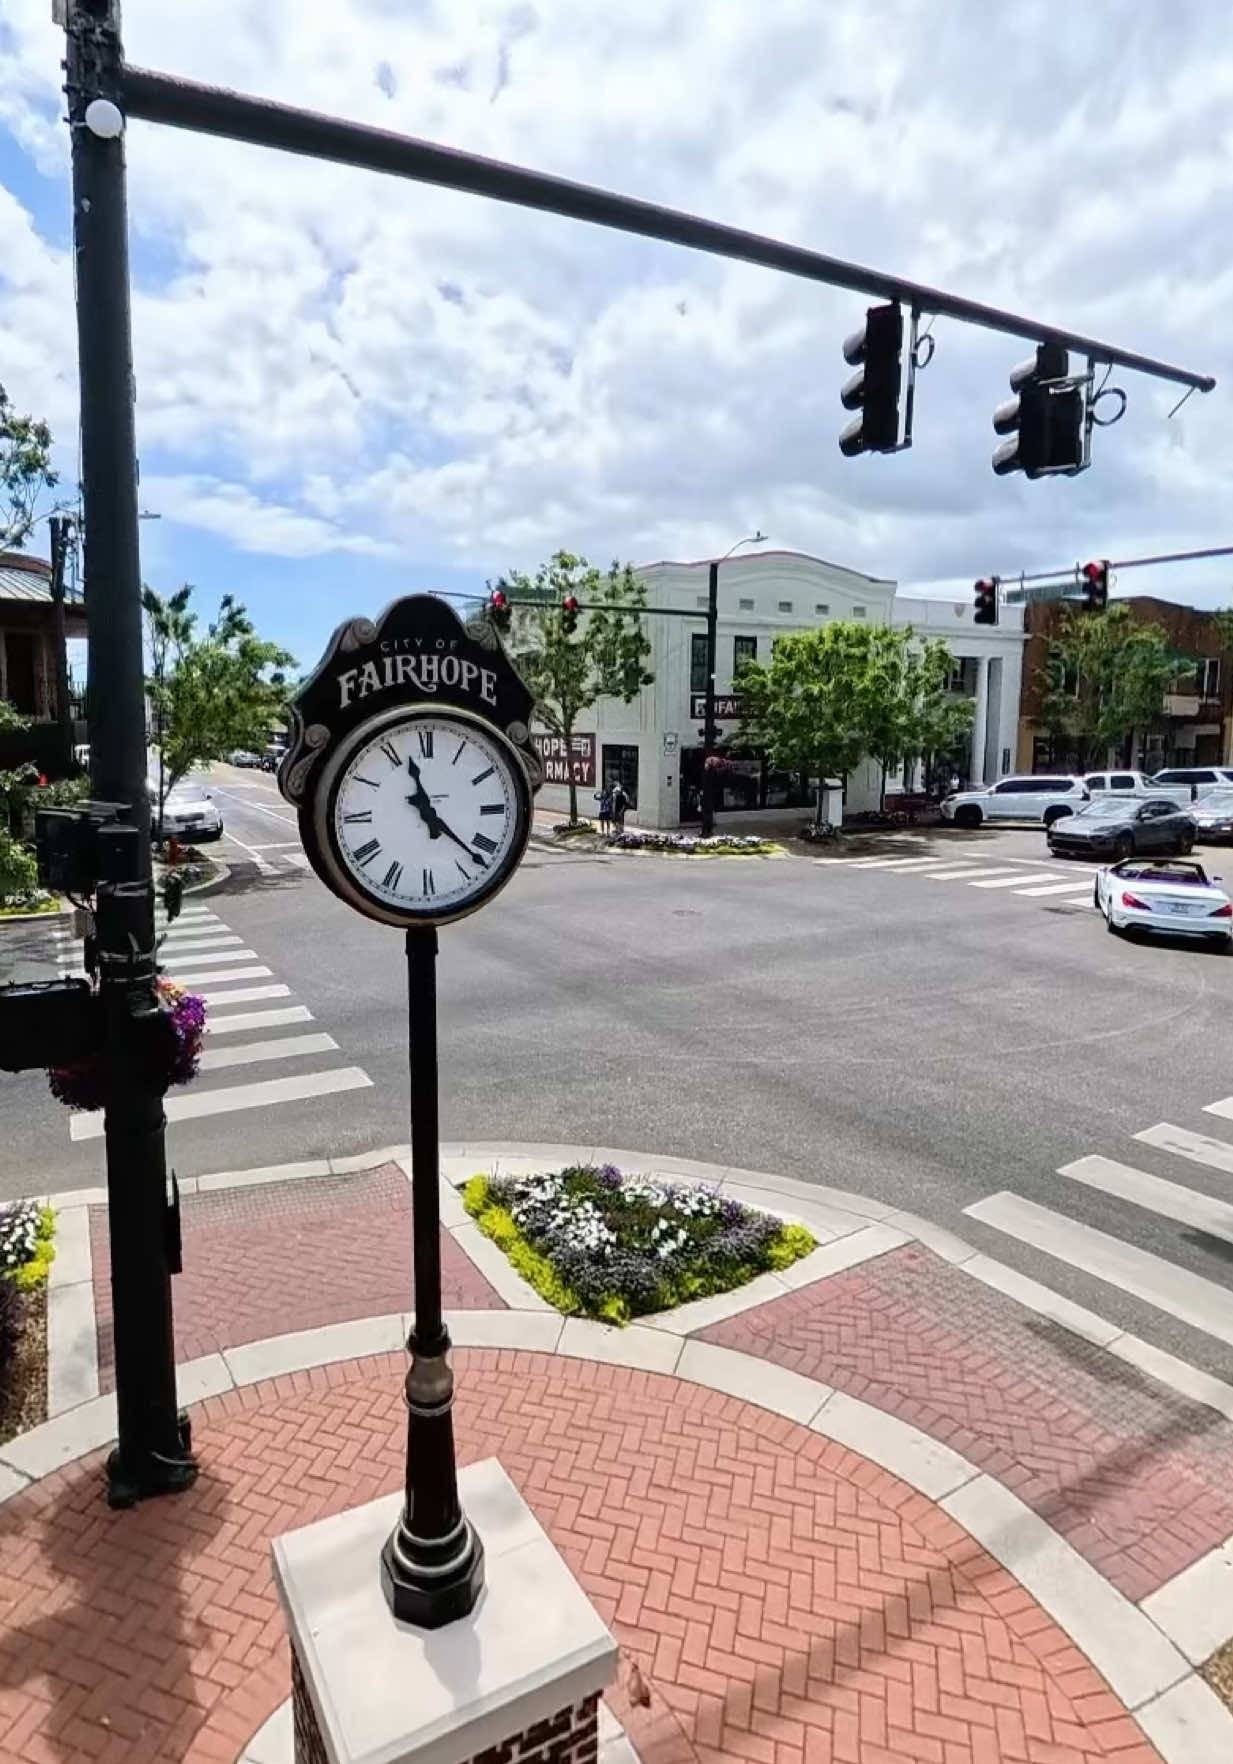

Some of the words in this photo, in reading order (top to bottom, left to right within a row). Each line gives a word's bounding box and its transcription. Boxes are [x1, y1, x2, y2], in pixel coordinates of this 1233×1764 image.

[380, 638, 423, 651] CITY
[435, 639, 458, 650] OF
[337, 654, 497, 709] FAIRHOPE
[535, 737, 568, 758] HOPE
[545, 760, 590, 783] RMACY
